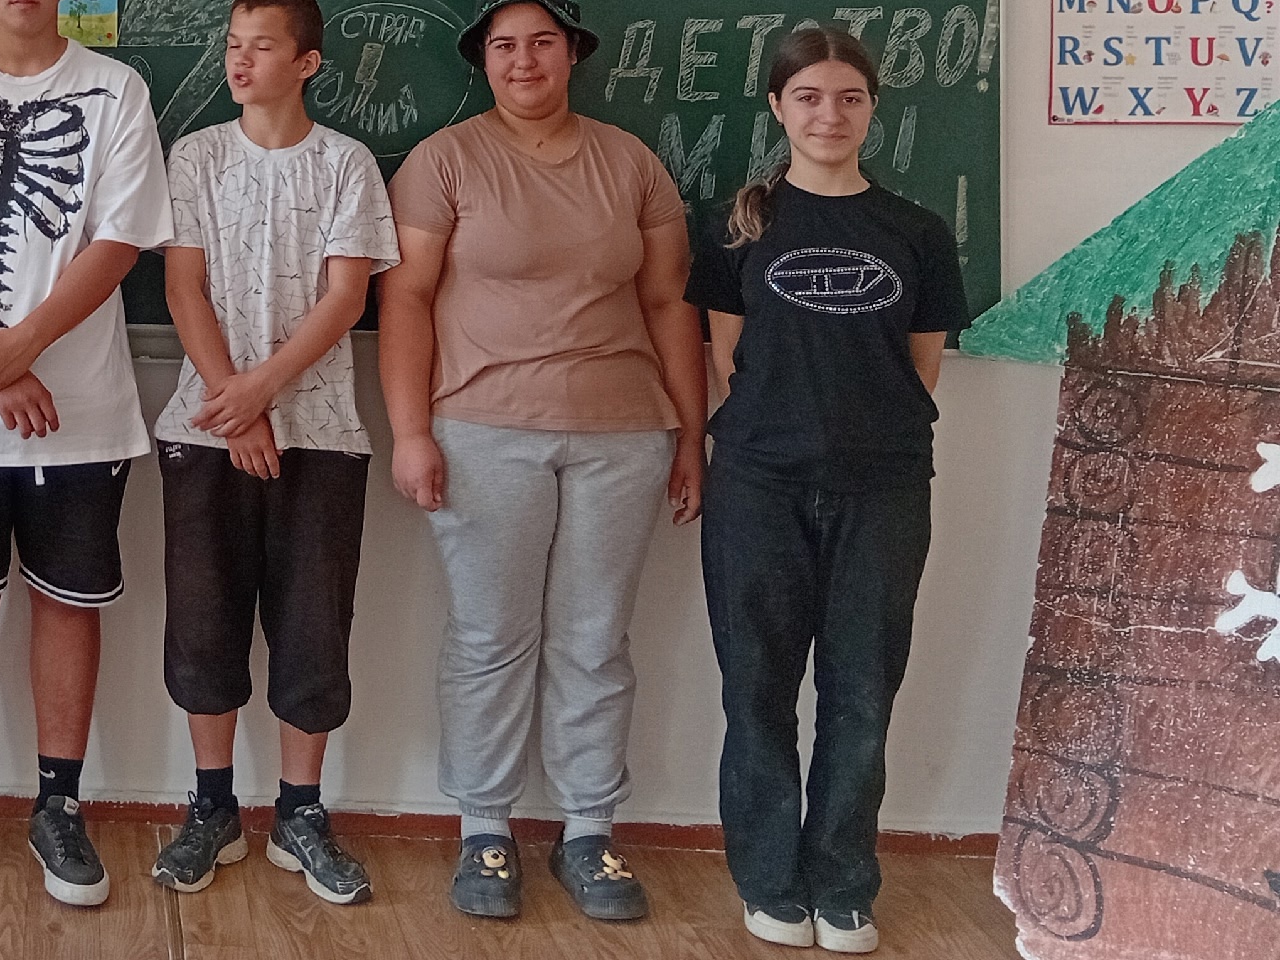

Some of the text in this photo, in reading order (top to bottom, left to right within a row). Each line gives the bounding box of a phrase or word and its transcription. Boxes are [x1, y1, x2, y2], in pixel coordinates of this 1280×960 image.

[1057, 35, 1264, 67] R S T U V
[1058, 86, 1100, 116] W
[1127, 86, 1155, 117] X
[1183, 87, 1211, 117] Y
[1235, 87, 1259, 117] Z
